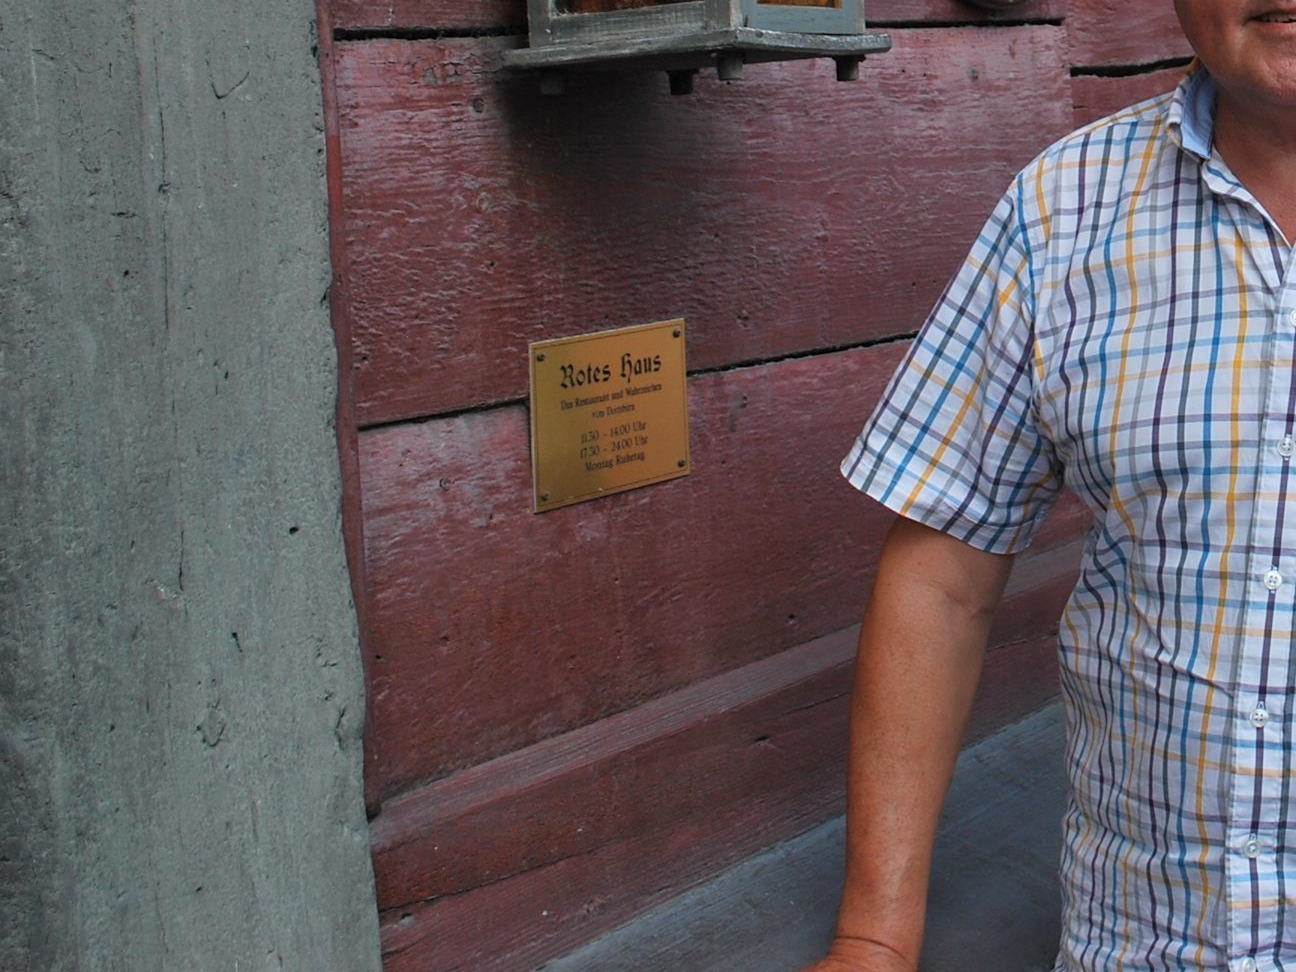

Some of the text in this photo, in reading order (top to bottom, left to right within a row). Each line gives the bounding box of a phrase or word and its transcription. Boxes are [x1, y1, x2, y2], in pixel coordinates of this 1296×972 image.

[560, 352, 662, 389] Rotes Haus
[611, 390, 623, 400] und
[632, 420, 647, 433] Uhr
[634, 434, 648, 447] Uhr
[585, 452, 645, 471] Montag Ruhetag
